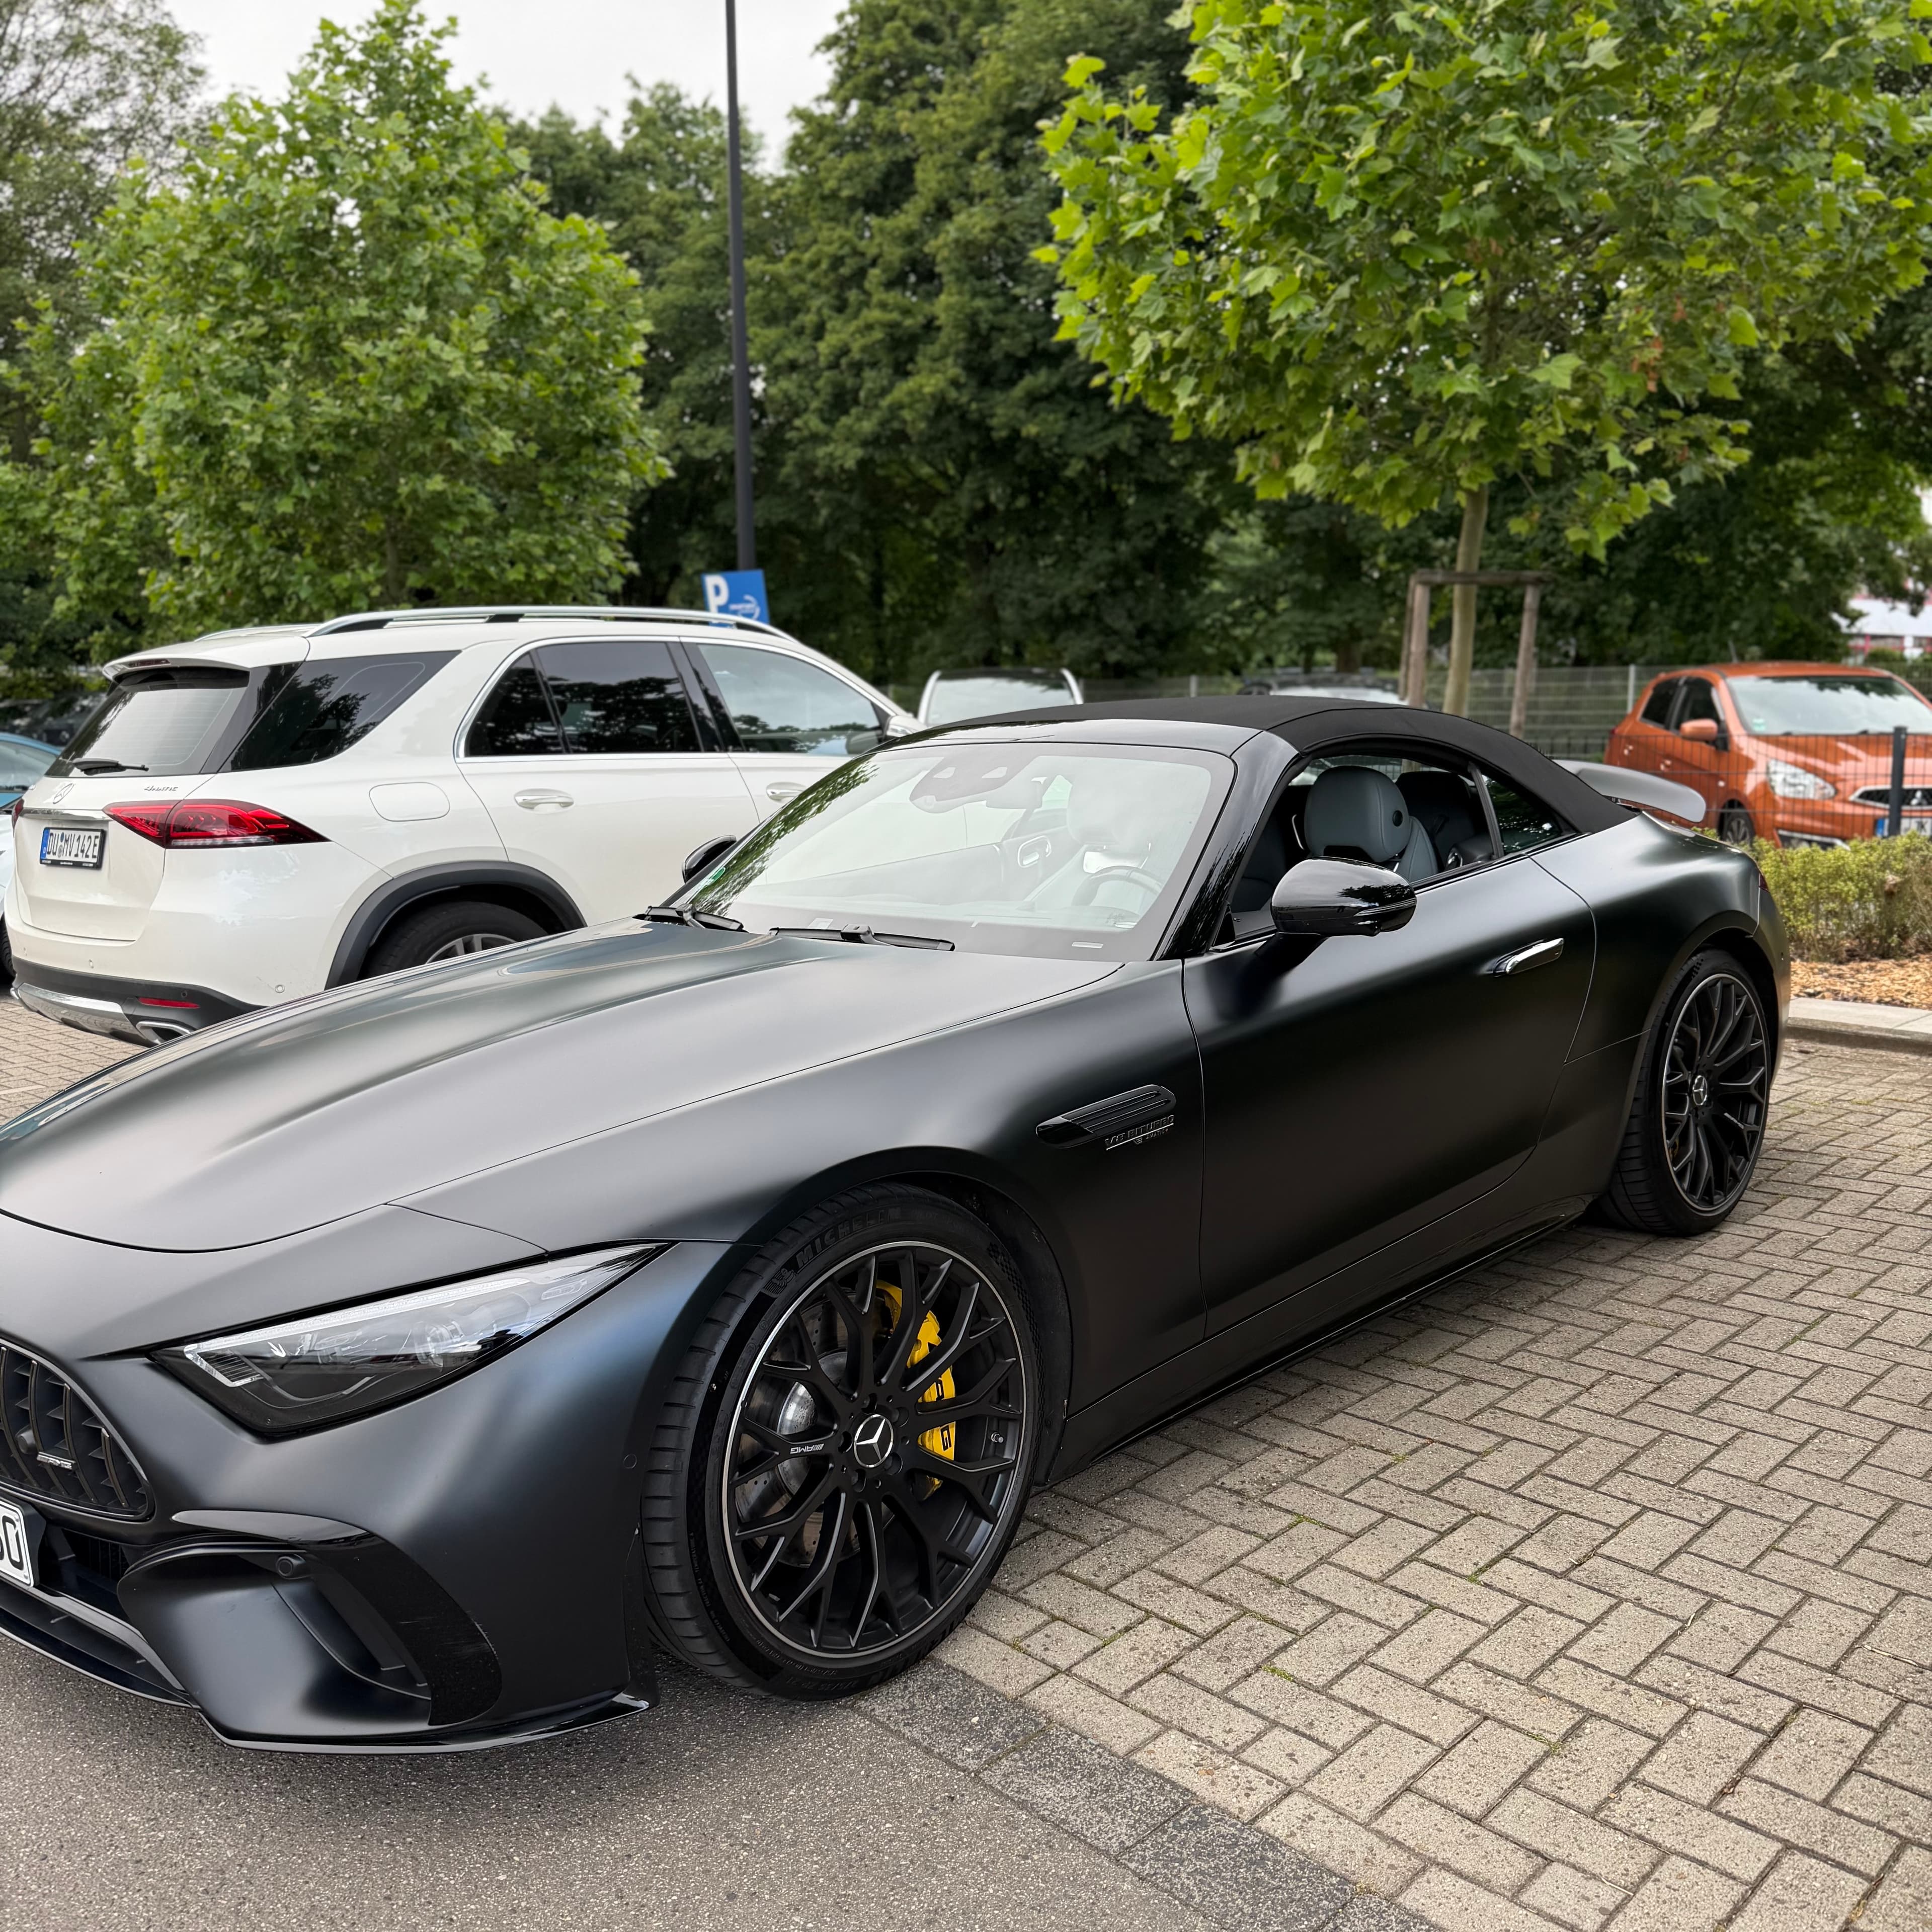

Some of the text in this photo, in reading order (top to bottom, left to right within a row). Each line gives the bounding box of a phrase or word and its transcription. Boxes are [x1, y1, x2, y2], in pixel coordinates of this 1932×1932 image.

[705, 575, 729, 614] P
[47, 833, 59, 856] DU
[62, 833, 75, 857] MV
[1128, 1114, 1175, 1138] BITURBO
[795, 1206, 901, 1268] MICHELIN
[0, 1515, 24, 1571] 0
